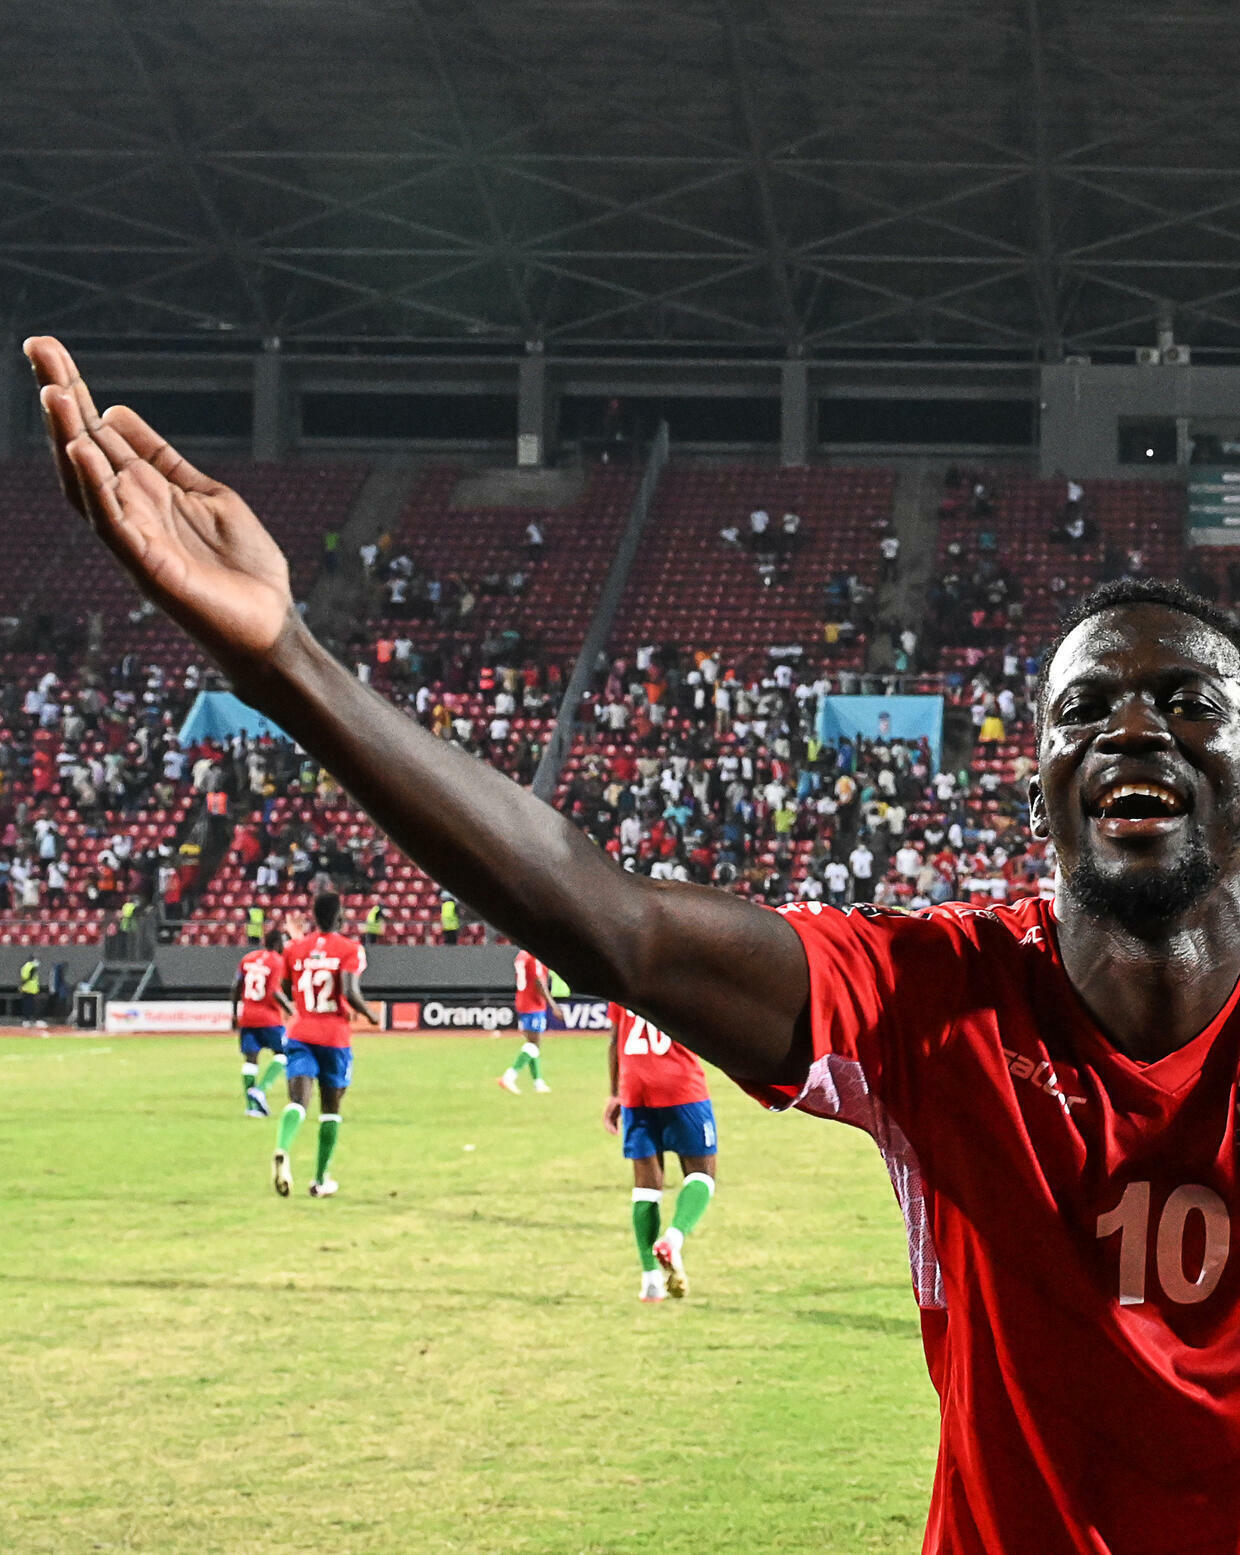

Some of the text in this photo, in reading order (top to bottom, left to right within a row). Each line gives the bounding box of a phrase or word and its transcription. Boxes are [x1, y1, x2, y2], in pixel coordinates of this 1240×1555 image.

[298, 969, 338, 1013] 12
[144, 1009, 234, 1024] TotalEnergie
[423, 1002, 513, 1030] Orange
[1096, 1181, 1231, 1306] 10
